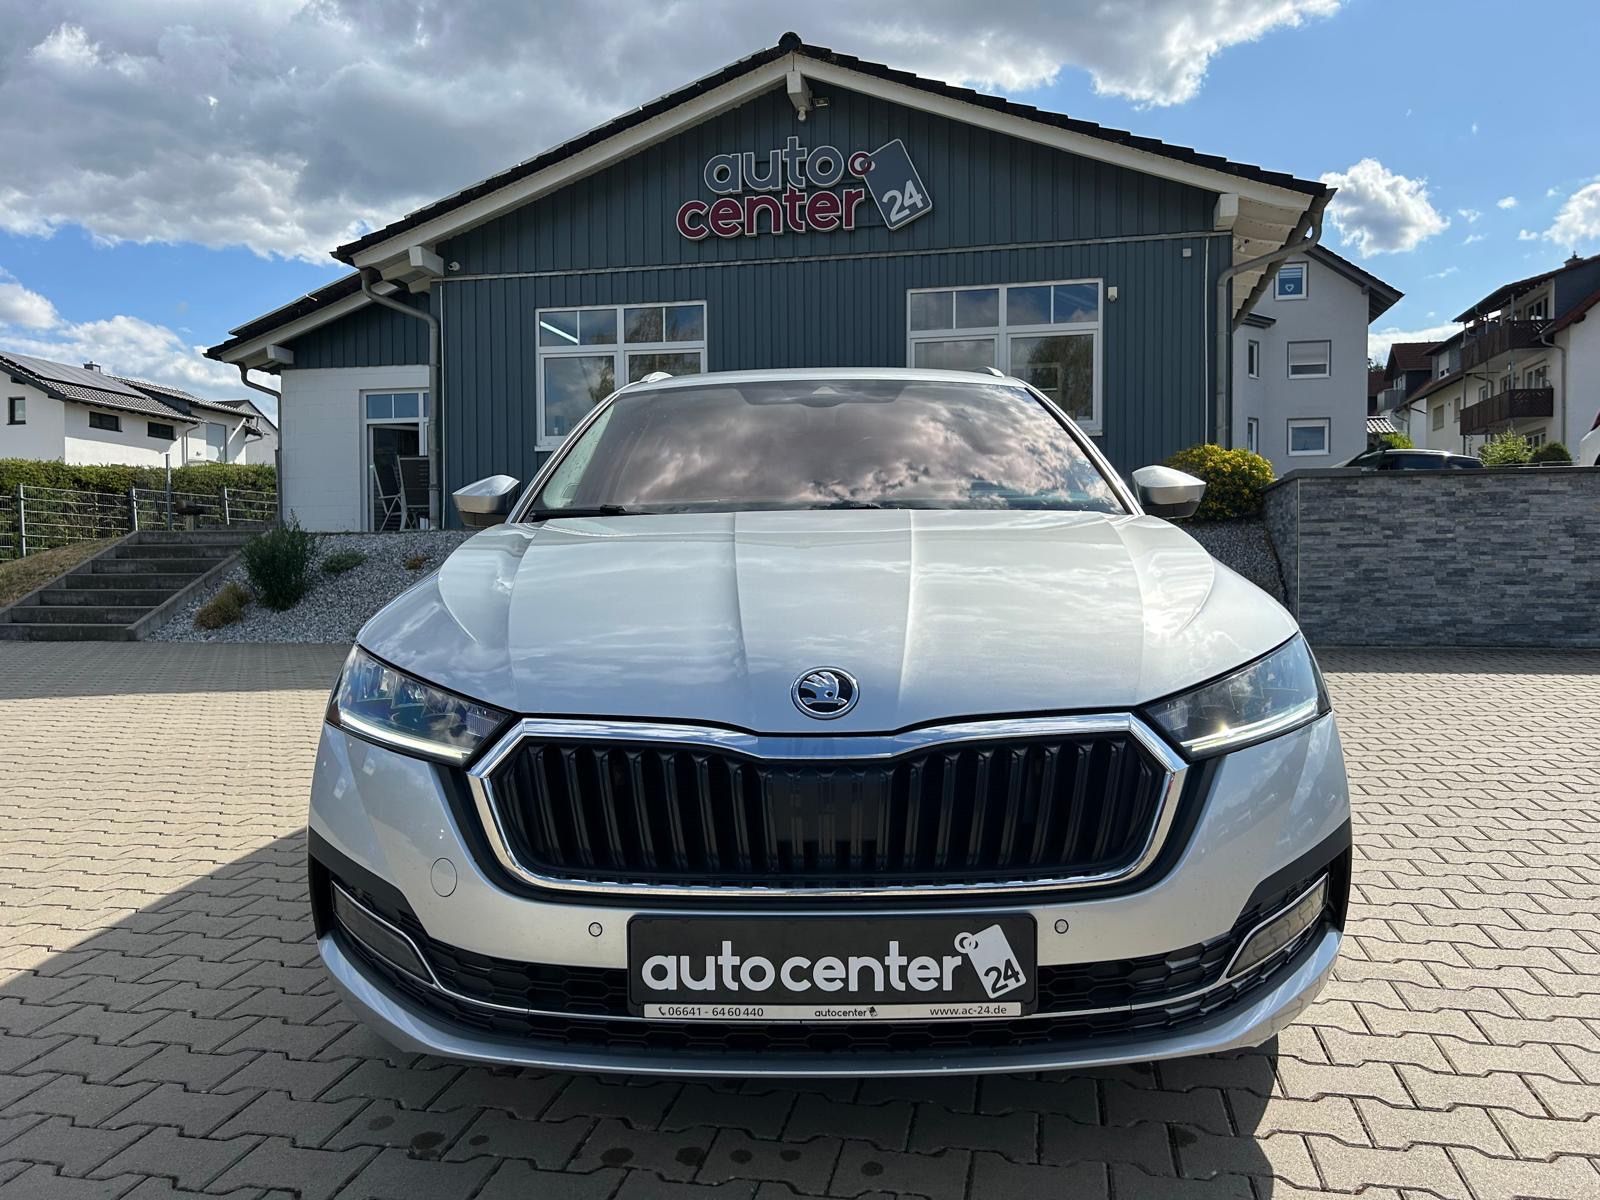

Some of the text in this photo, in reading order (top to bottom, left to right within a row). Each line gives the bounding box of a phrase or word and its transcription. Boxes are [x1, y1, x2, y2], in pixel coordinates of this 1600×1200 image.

[703, 136, 845, 194] auto
[676, 186, 864, 240] center
[881, 179, 923, 223] 24
[641, 940, 962, 992] autocenter
[983, 958, 1021, 995] 24
[814, 1006, 867, 1017] autocenter
[929, 1005, 1008, 1016] www.ac-24.de
